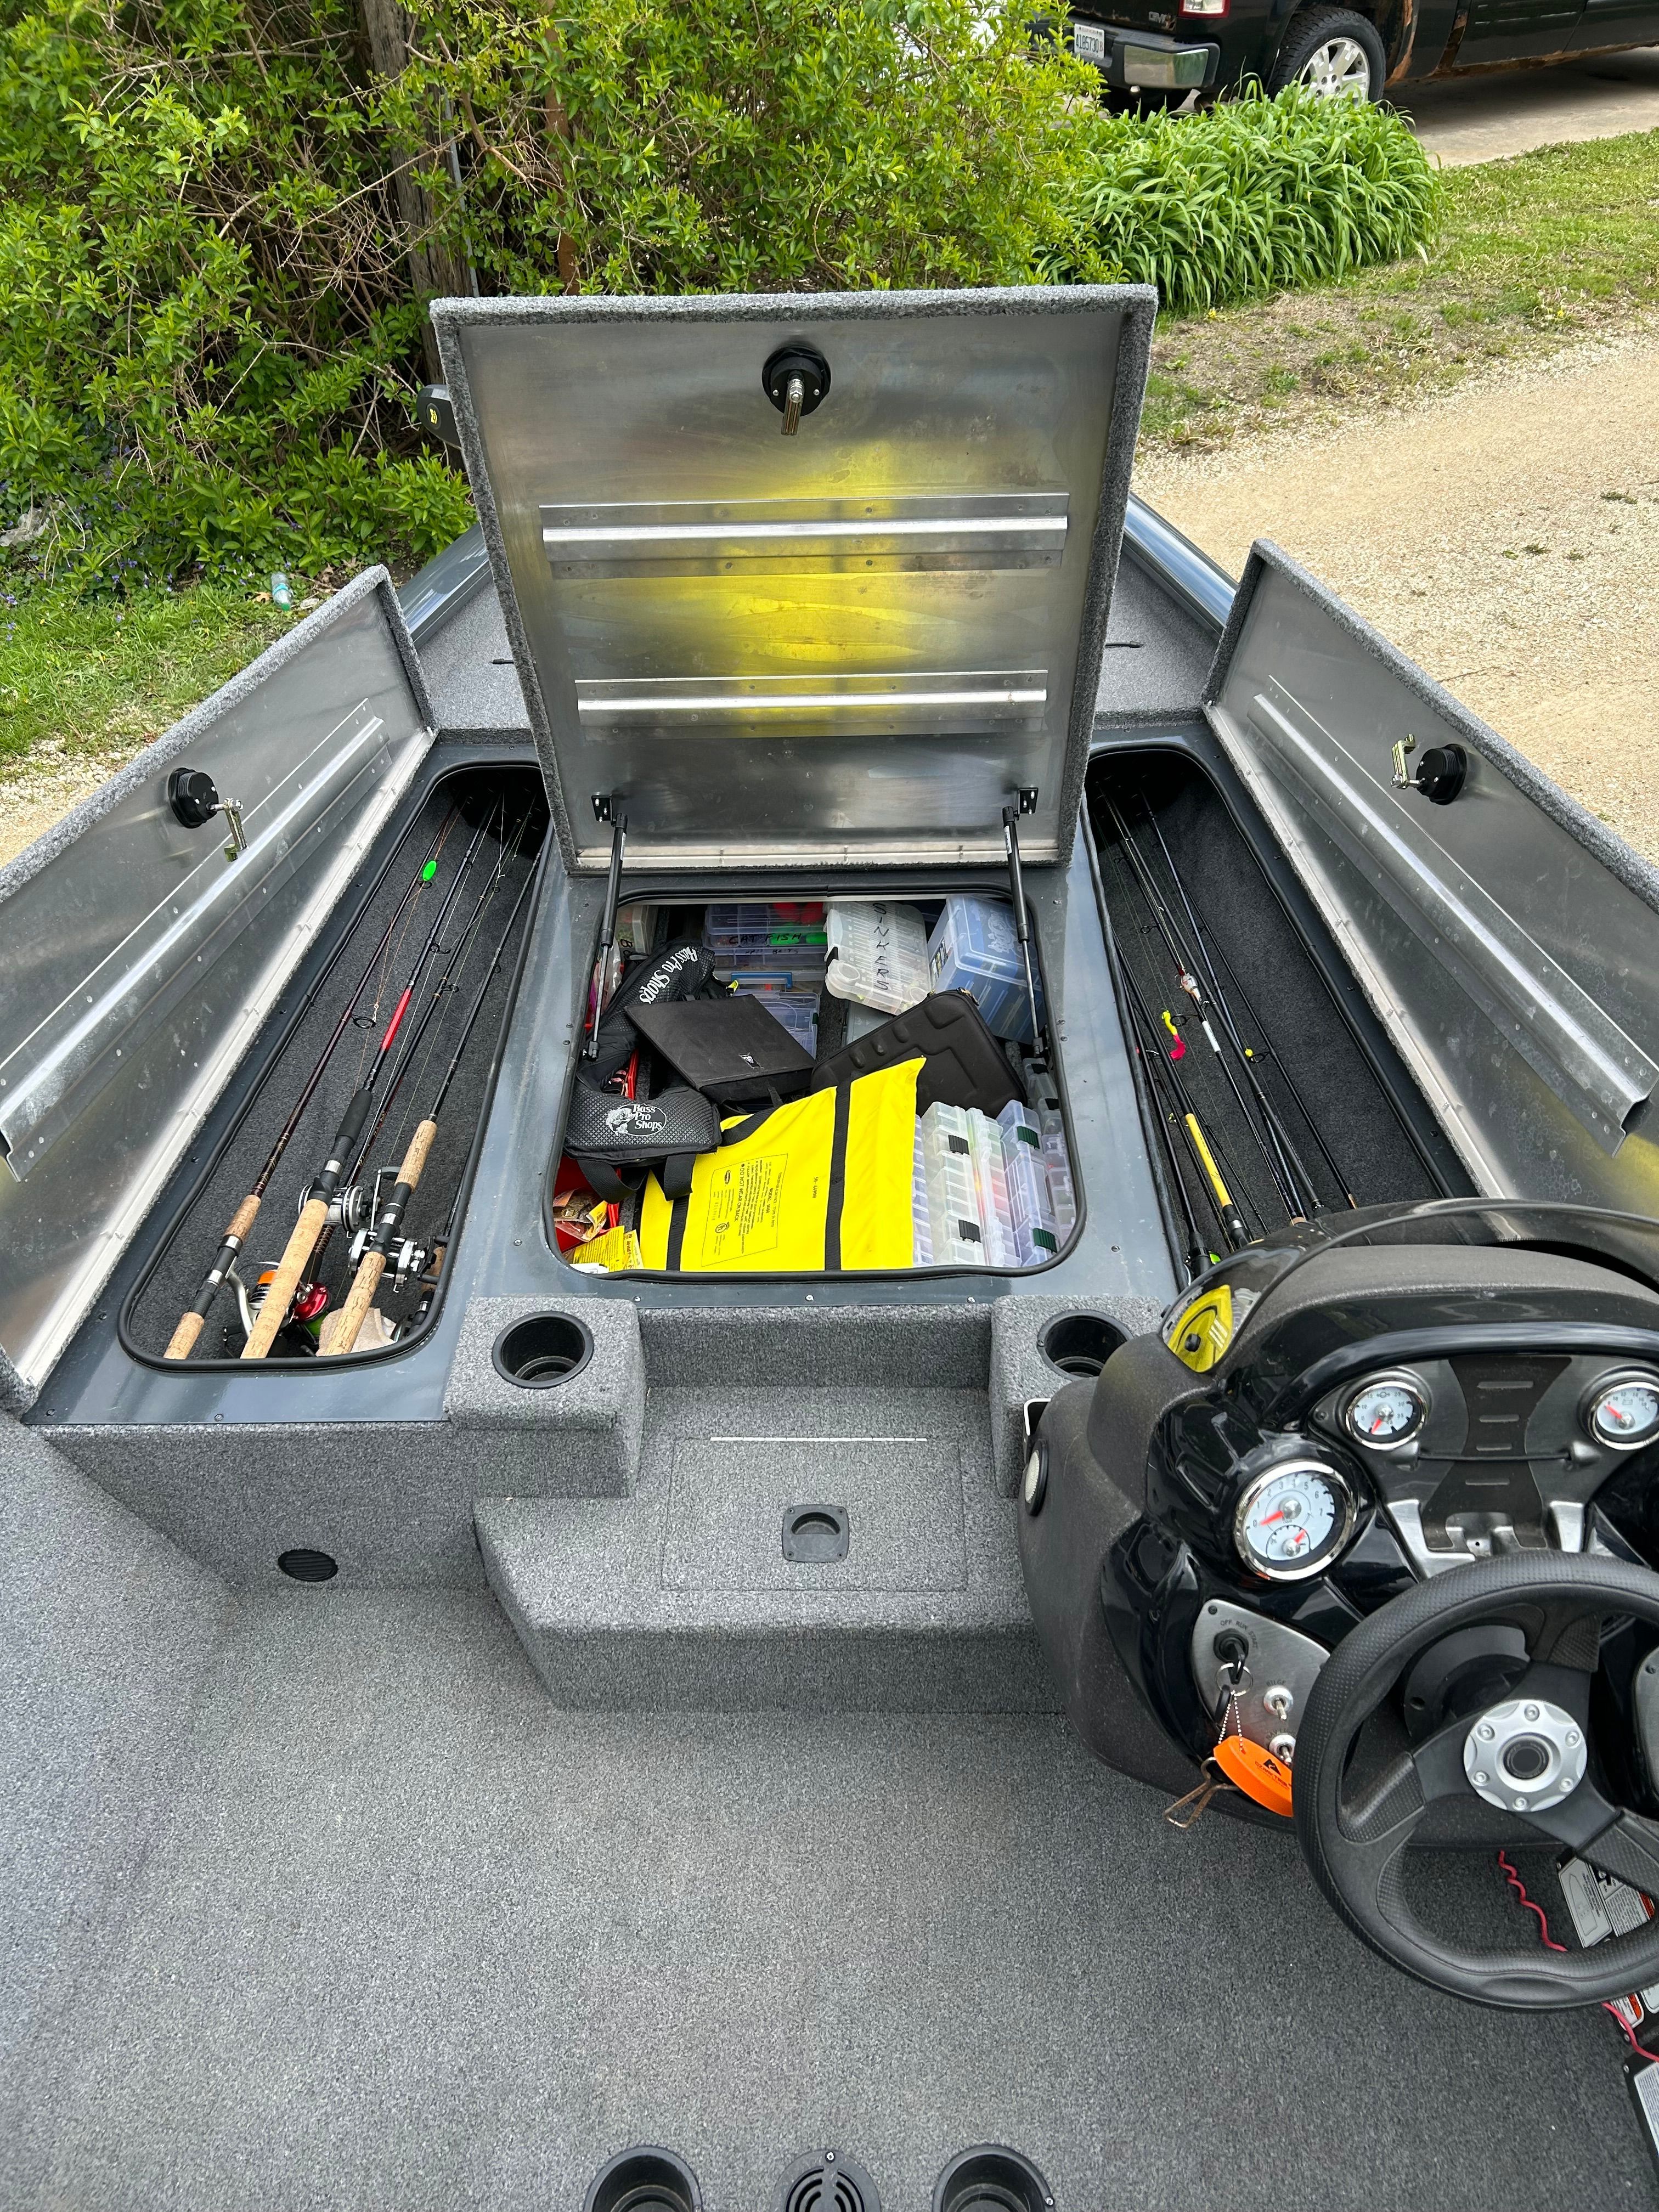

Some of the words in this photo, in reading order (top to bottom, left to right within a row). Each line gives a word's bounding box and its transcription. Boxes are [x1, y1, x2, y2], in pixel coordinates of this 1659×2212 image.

[729, 934, 758, 944] CAT
[765, 933, 802, 942] FISH
[872, 902, 890, 990] SINKERS
[675, 946, 698, 963] Bass
[661, 956, 682, 973] Pro
[638, 969, 670, 1005] Shops
[633, 1104, 656, 1113] Bass
[634, 1111, 651, 1121] Pro
[634, 1120, 663, 1131] Shops
[1291, 1480, 1296, 1488] 4
[1267, 1488, 1272, 1497] 2
